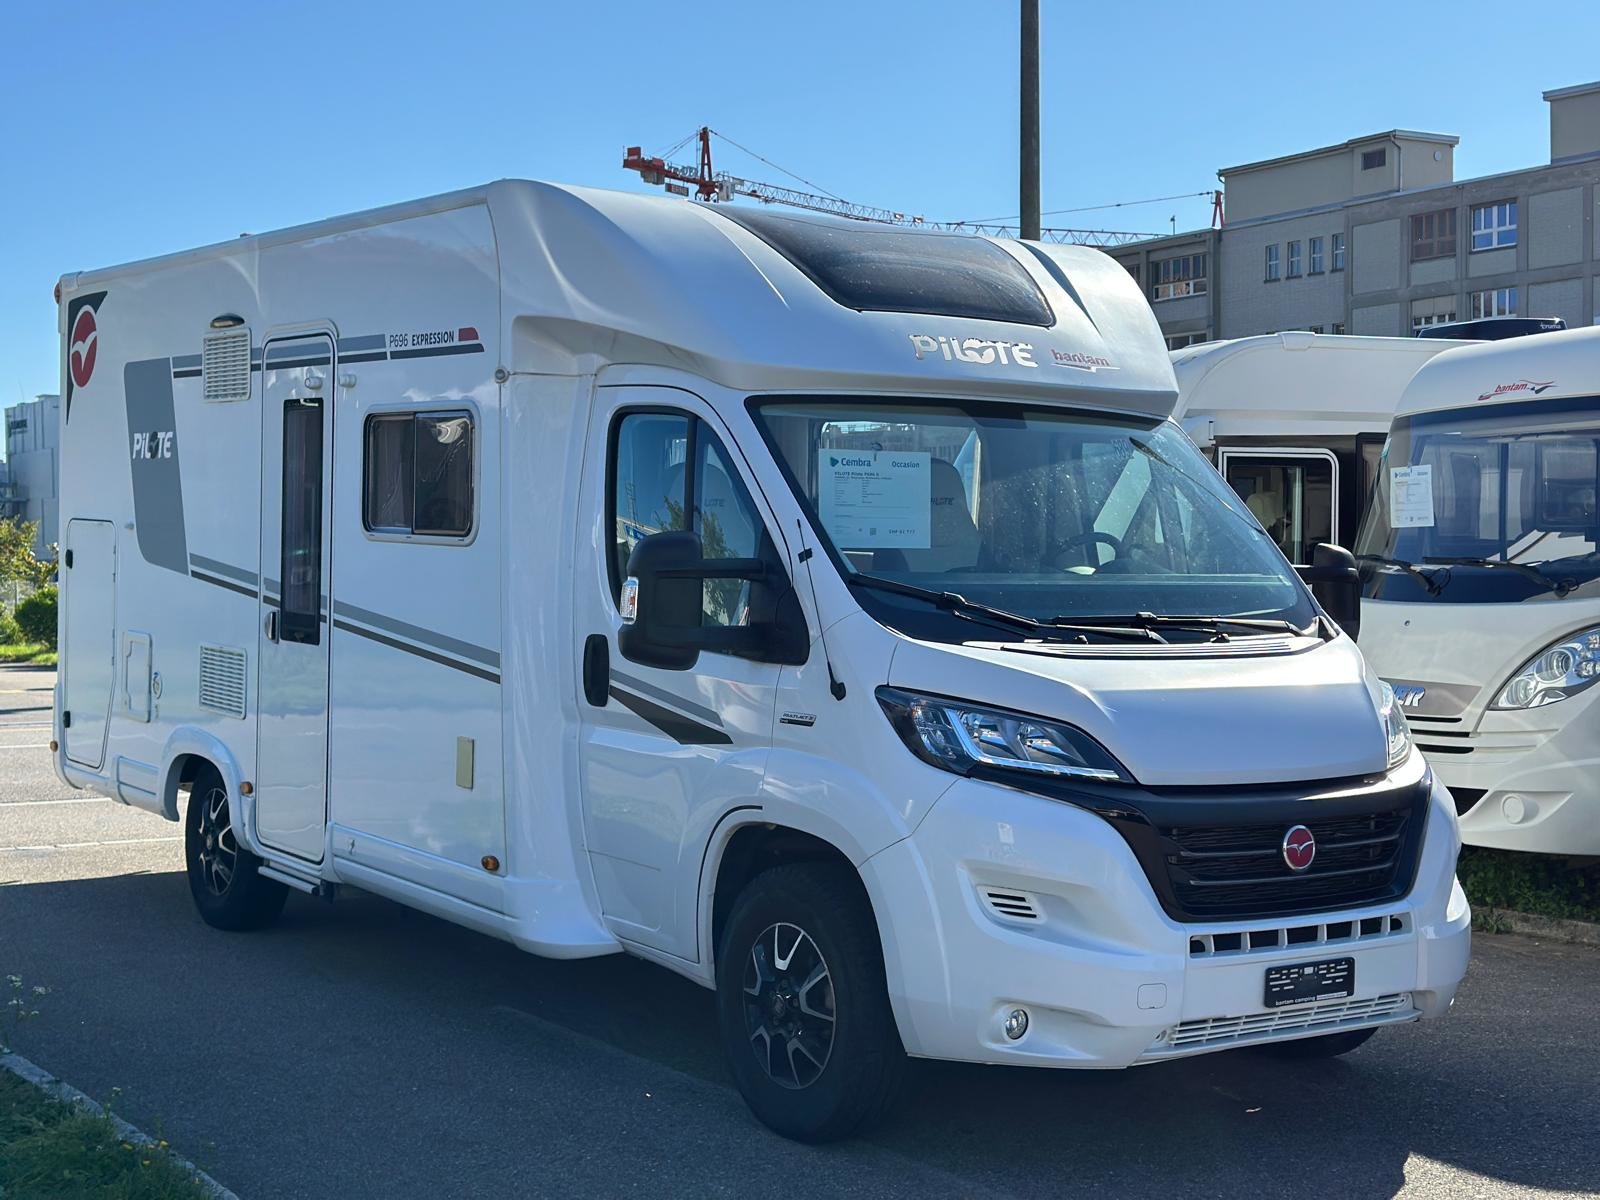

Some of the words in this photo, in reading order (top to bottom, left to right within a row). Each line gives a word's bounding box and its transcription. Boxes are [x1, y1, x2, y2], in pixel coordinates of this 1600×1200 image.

[389, 333, 409, 348] P696
[411, 330, 455, 346] EXPRESSION
[1050, 348, 1110, 367] bantam
[1494, 383, 1528, 393] bantam
[841, 457, 872, 467] Cembra
[892, 460, 920, 468] Occasion
